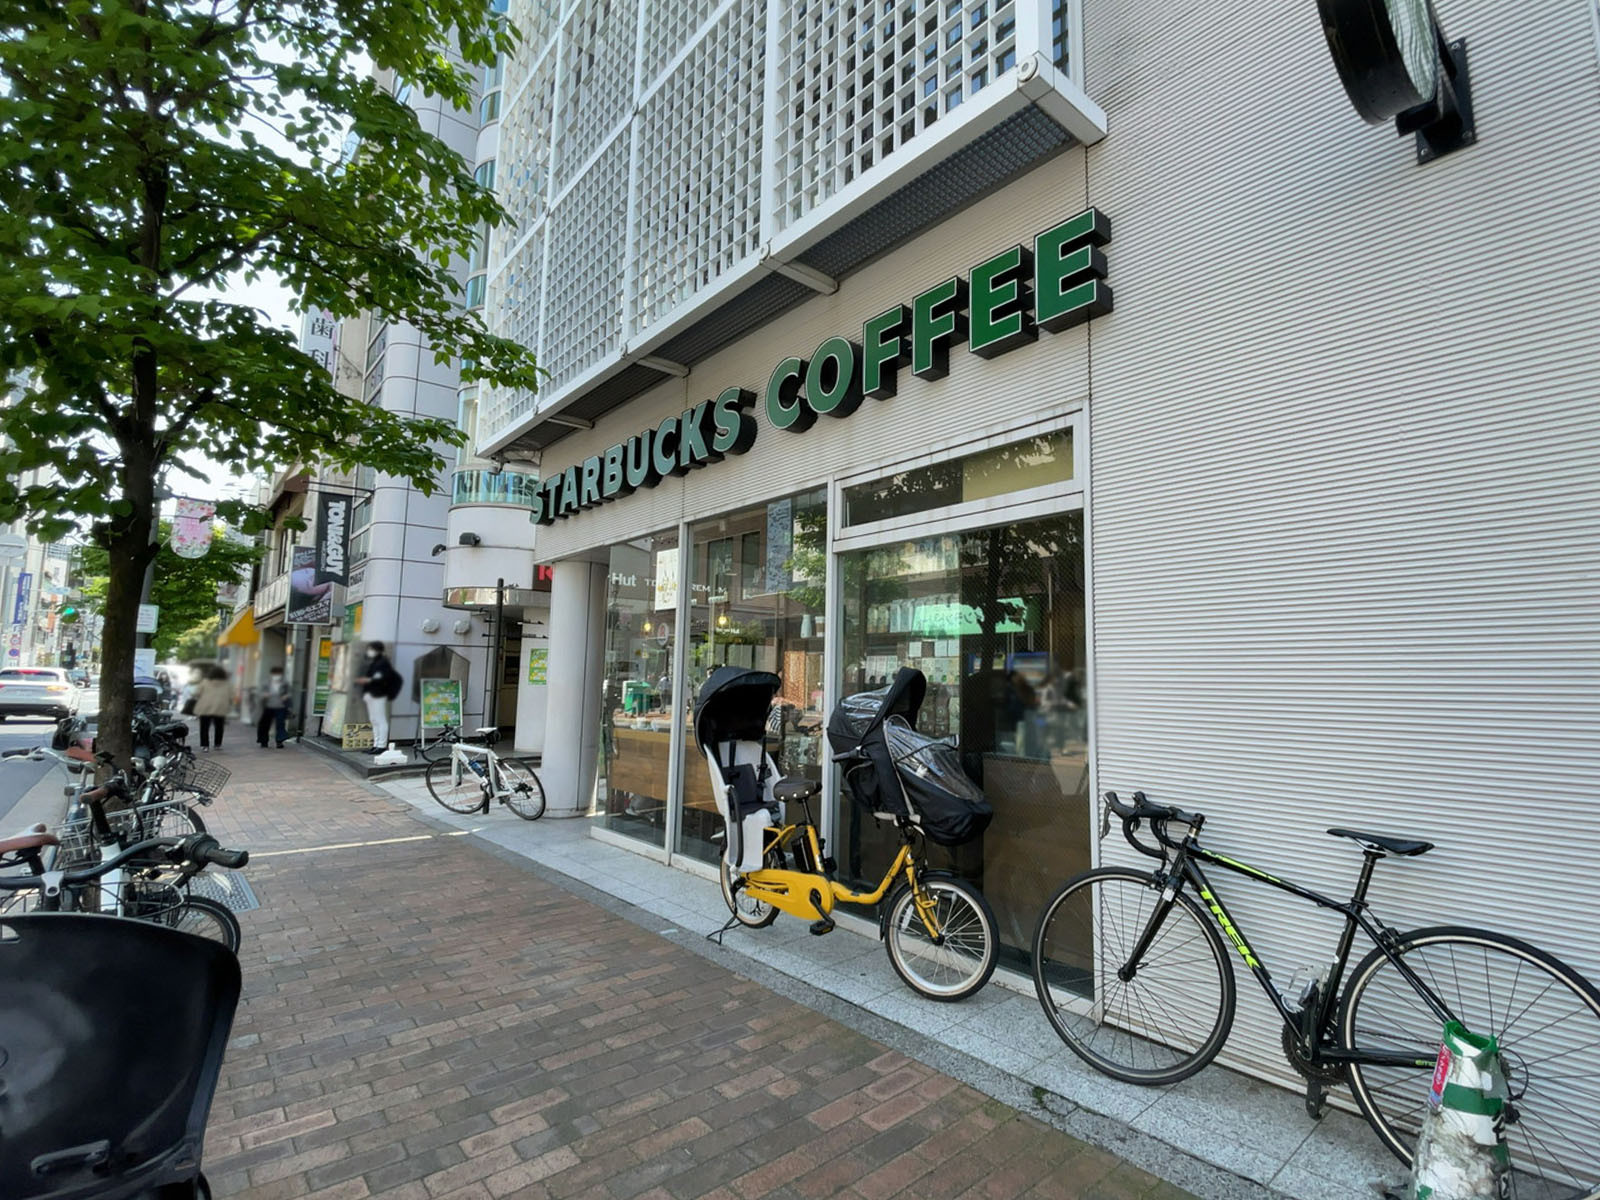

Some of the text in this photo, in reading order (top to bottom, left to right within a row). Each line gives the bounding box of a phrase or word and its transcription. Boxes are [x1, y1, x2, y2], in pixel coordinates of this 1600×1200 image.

[530, 207, 1099, 525] STARBUCKS COFFEE
[1200, 883, 1261, 969] TREK
